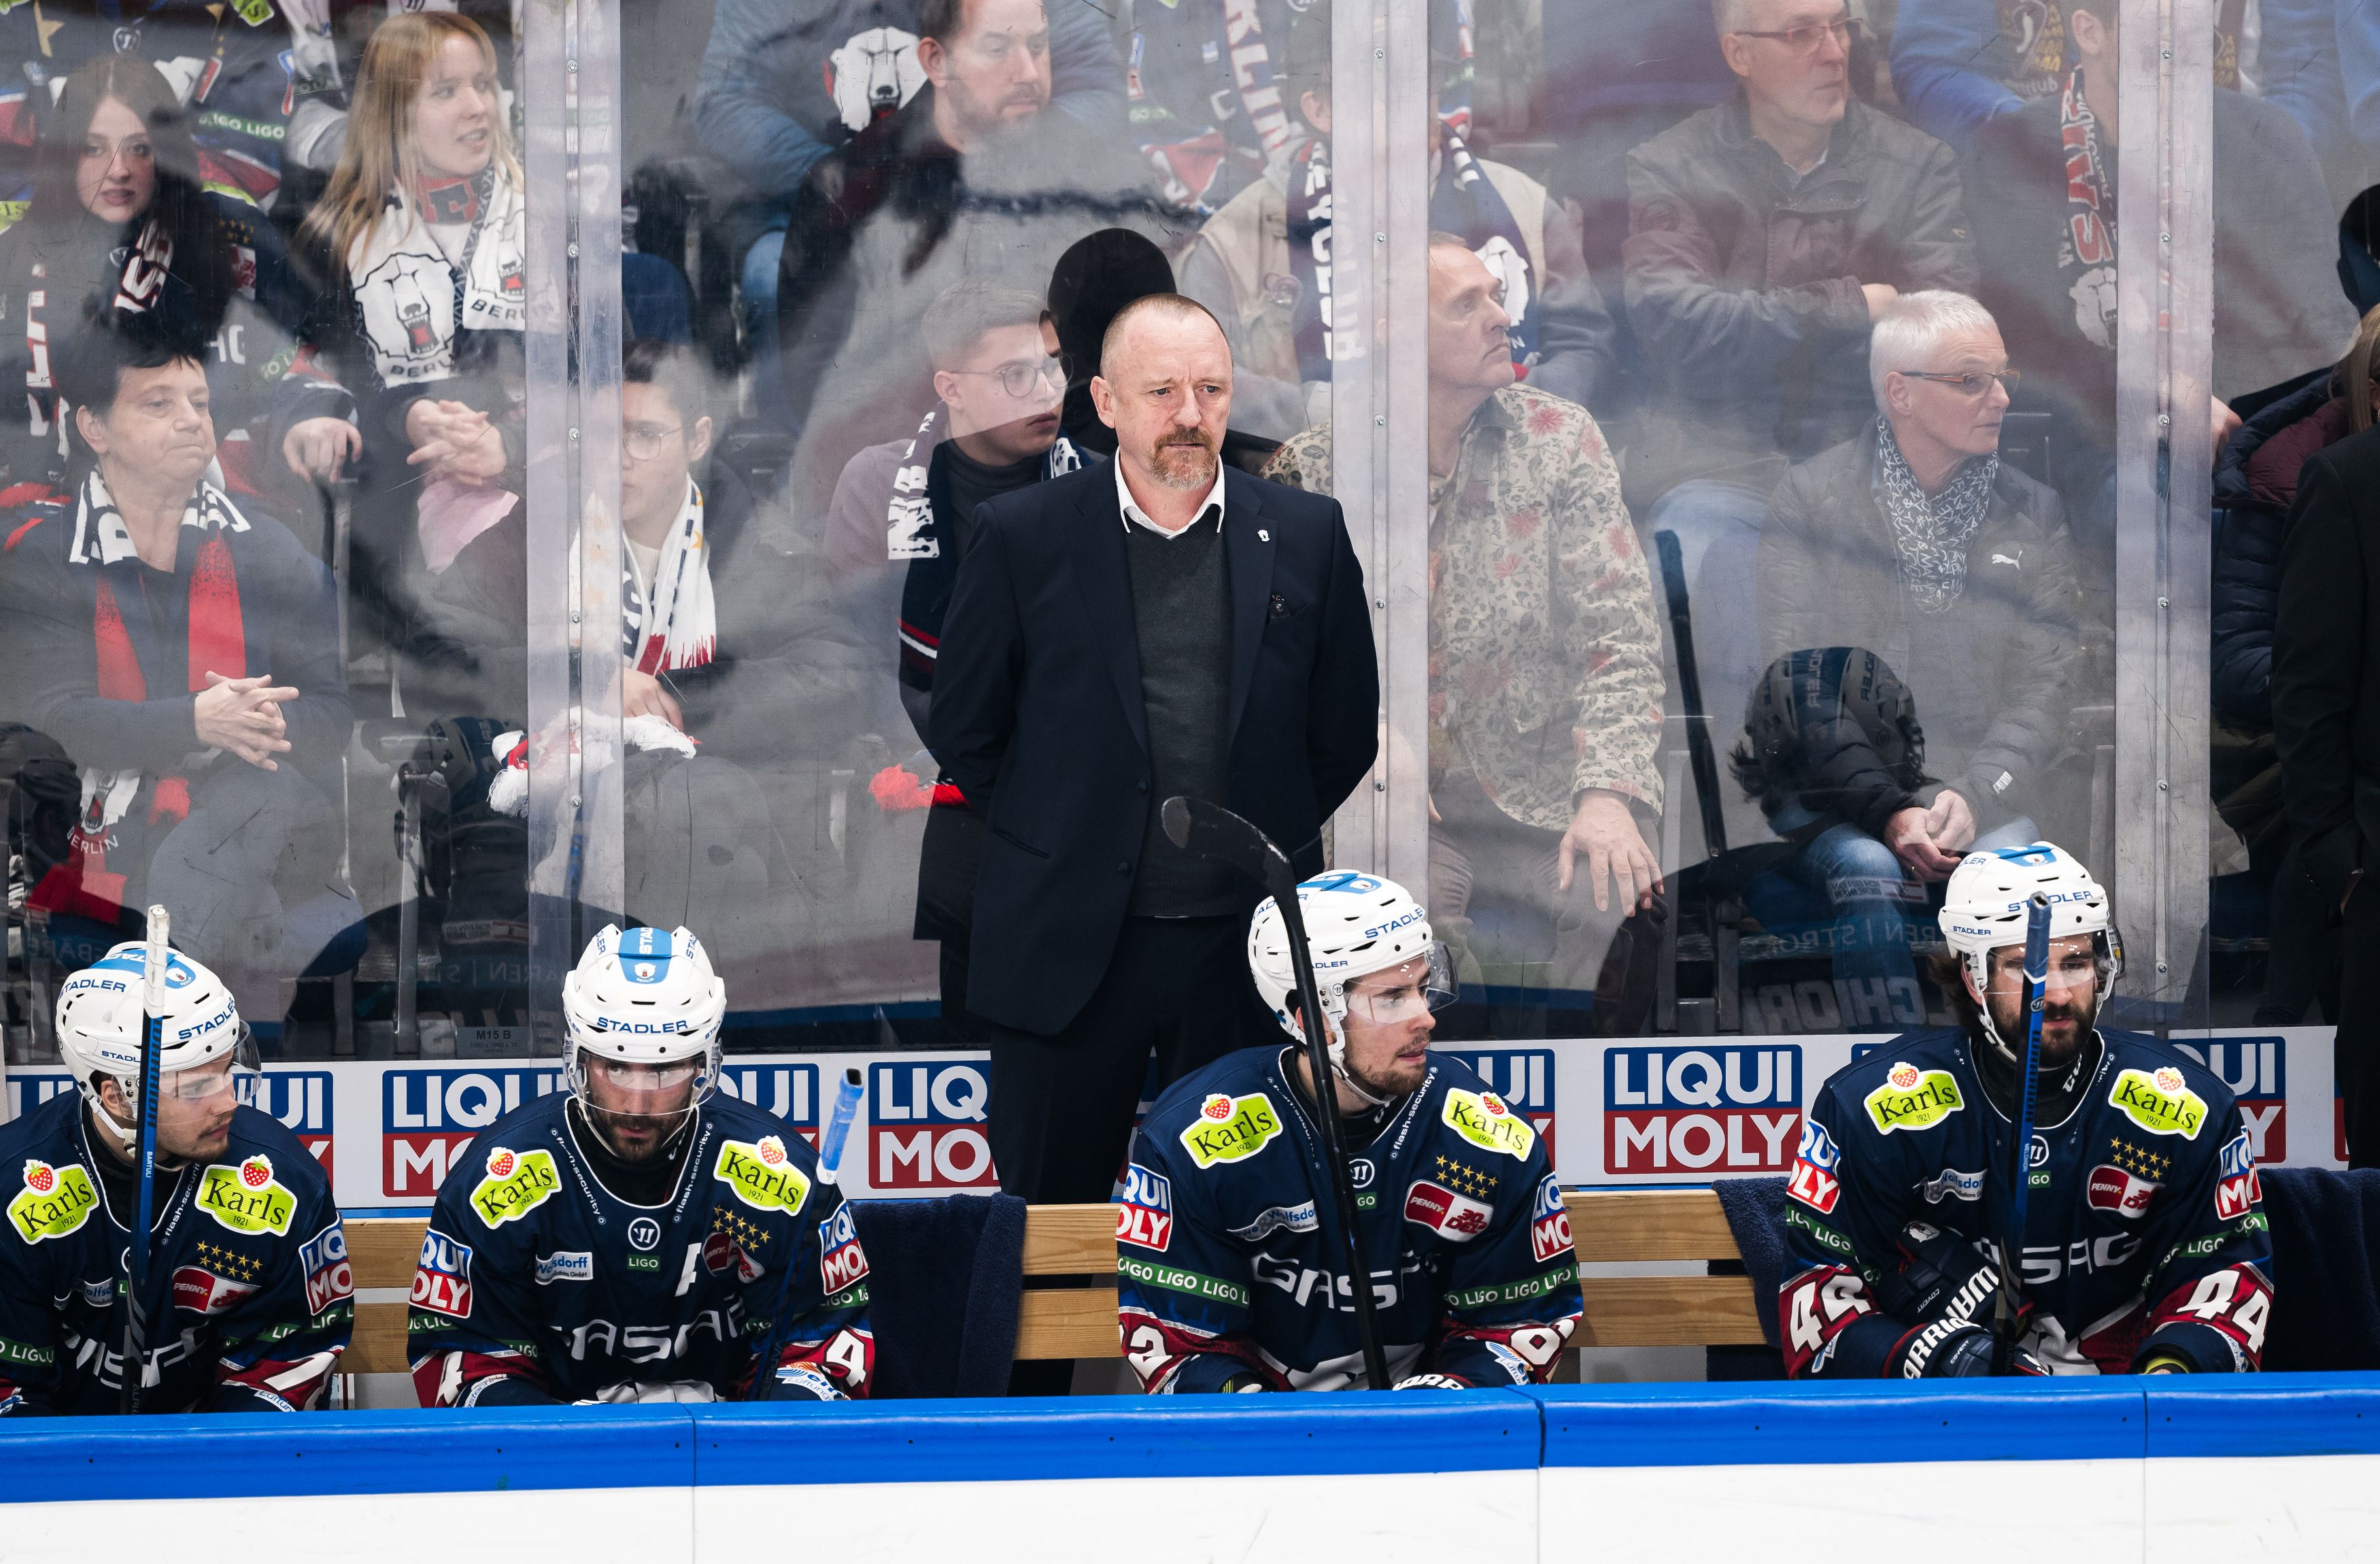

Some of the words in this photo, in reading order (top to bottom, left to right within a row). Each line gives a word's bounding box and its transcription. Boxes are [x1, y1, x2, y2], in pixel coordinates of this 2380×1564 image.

[247, 122, 286, 139] LIGO
[2007, 890, 2094, 913] STDLER
[639, 927, 653, 955] STAD
[1953, 925, 1991, 936] STADLER
[686, 934, 697, 960] STAD
[1312, 960, 1348, 969] DLER
[476, 1030, 500, 1040] M15
[503, 1030, 511, 1040] B
[596, 1017, 689, 1034] STADLER
[704, 1019, 721, 1040] STAD
[101, 1051, 141, 1064] STADL
[879, 1066, 988, 1122] LIQ
[1614, 1051, 1792, 1108] LIQUI
[1393, 1073, 1435, 1150] flash-security
[1877, 1081, 1956, 1124] Karls
[2122, 1080, 2196, 1131] Karls
[1192, 1110, 1272, 1158] Karls
[1451, 1100, 1525, 1151] Karls
[2145, 1115, 2161, 1127] 1921
[1236, 1141, 1252, 1152] 1921
[1478, 1134, 1494, 1145] 1921
[1614, 1113, 1800, 1169] MOLY
[145, 1151, 153, 1178] BARTULI
[676, 1129, 709, 1214] flash-security
[879, 1129, 991, 1183] MO
[479, 1163, 553, 1218] Karls
[723, 1151, 798, 1205] Karls
[18, 1182, 92, 1235] Karls
[165, 1163, 201, 1236] flash-securit
[205, 1177, 285, 1227] Karls
[520, 1194, 534, 1207] 1921
[748, 1189, 764, 1202] 1921
[1357, 1196, 1376, 1206] GO
[1536, 1176, 1562, 1217] LIQ
[61, 1215, 77, 1228] 1921
[233, 1215, 248, 1227] 1921
[824, 1210, 856, 1252] LIQ
[305, 1228, 347, 1270] LIQ
[1536, 1220, 1573, 1257] MO
[1814, 1227, 1851, 1251] LIGO
[628, 1257, 658, 1269] LIGO
[824, 1244, 865, 1289] MO
[309, 1265, 354, 1311] MO
[1157, 1270, 1197, 1289] LIGO
[1202, 1280, 1238, 1301] LIGO
[1505, 1280, 1540, 1300] LIGO
[2177, 1269, 2271, 1355] 44
[1128, 1325, 1173, 1381] 2
[1950, 1339, 1971, 1365] COVERT
